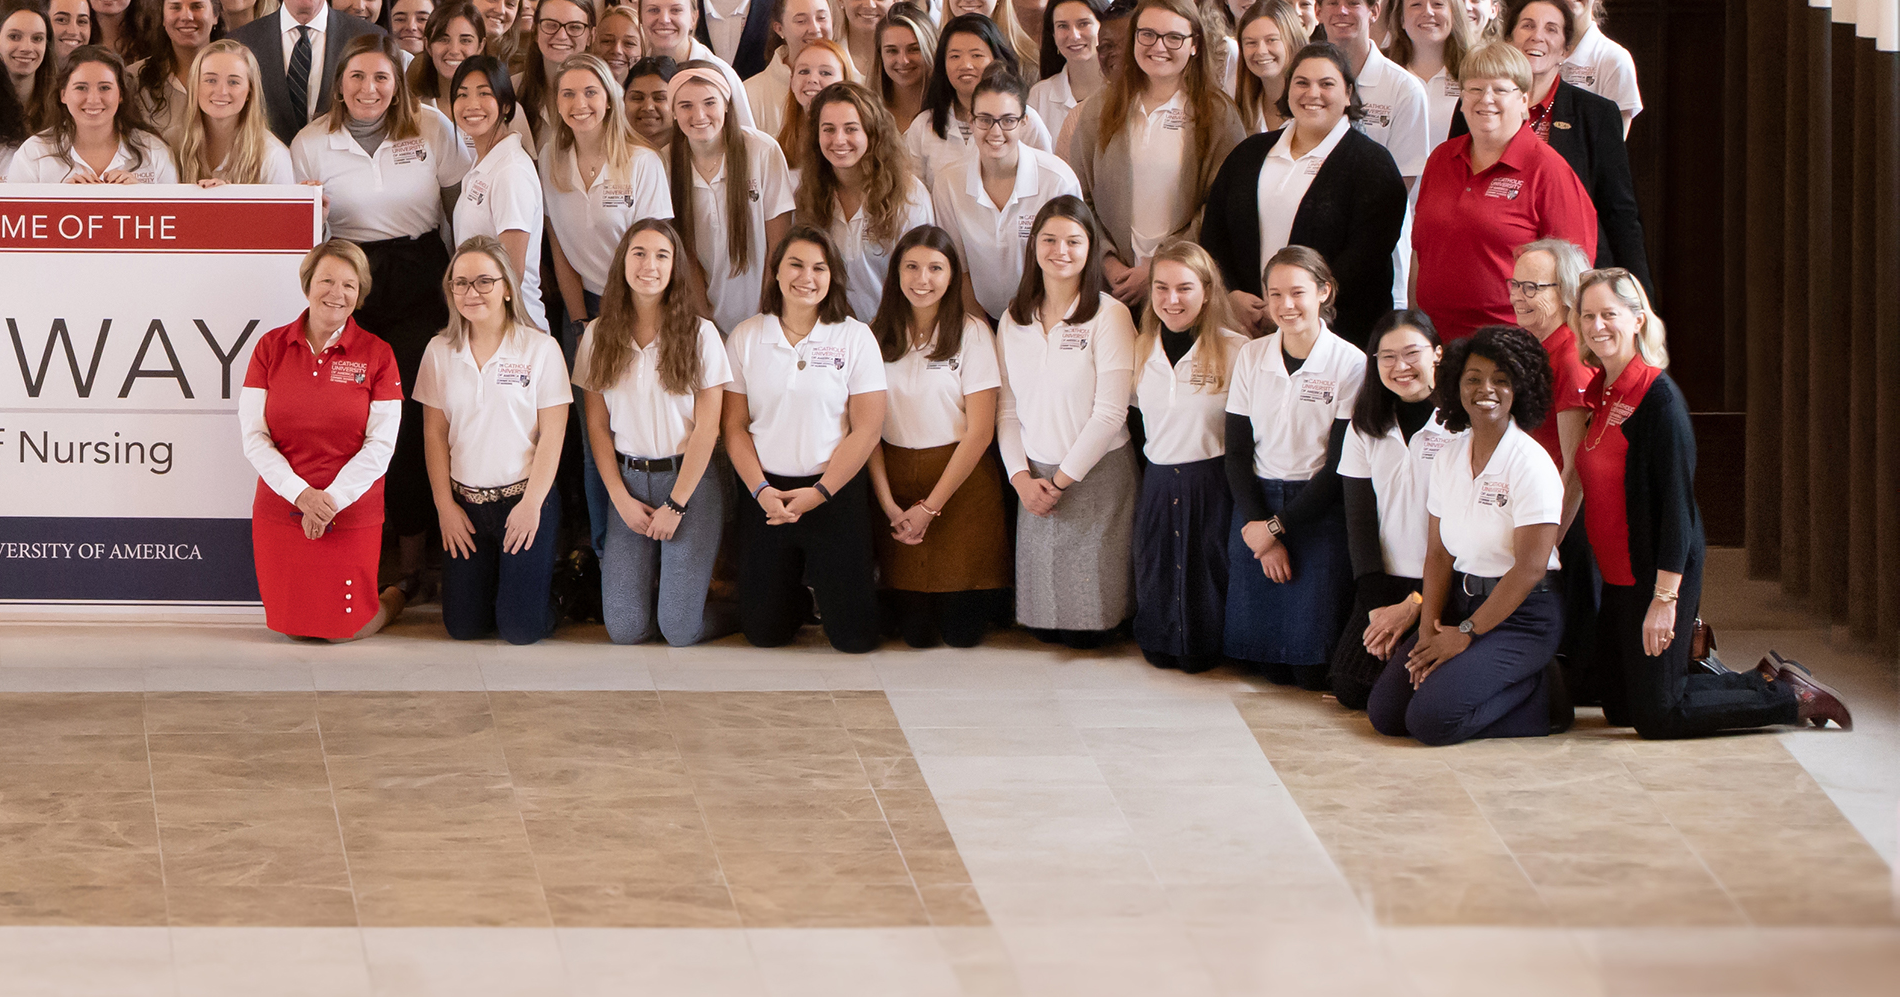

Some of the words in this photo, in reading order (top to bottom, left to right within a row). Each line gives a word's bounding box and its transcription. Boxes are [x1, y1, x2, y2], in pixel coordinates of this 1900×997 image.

[395, 138, 426, 148] CATHOLIC
[391, 143, 426, 154] UNIVERSITY
[58, 214, 104, 240] OF
[112, 215, 177, 240] THE
[337, 360, 368, 368] CATHOLIC
[504, 362, 532, 370] CATHOLIC
[331, 365, 367, 374] UNIVERSITY
[498, 367, 531, 376] UNIVERSITY
[1308, 379, 1336, 387] CATHOLIC
[1301, 384, 1335, 392] UNIVERSITY
[19, 430, 173, 475] Nursing
[78, 543, 105, 559] OF
[108, 543, 203, 560] AMERICA
